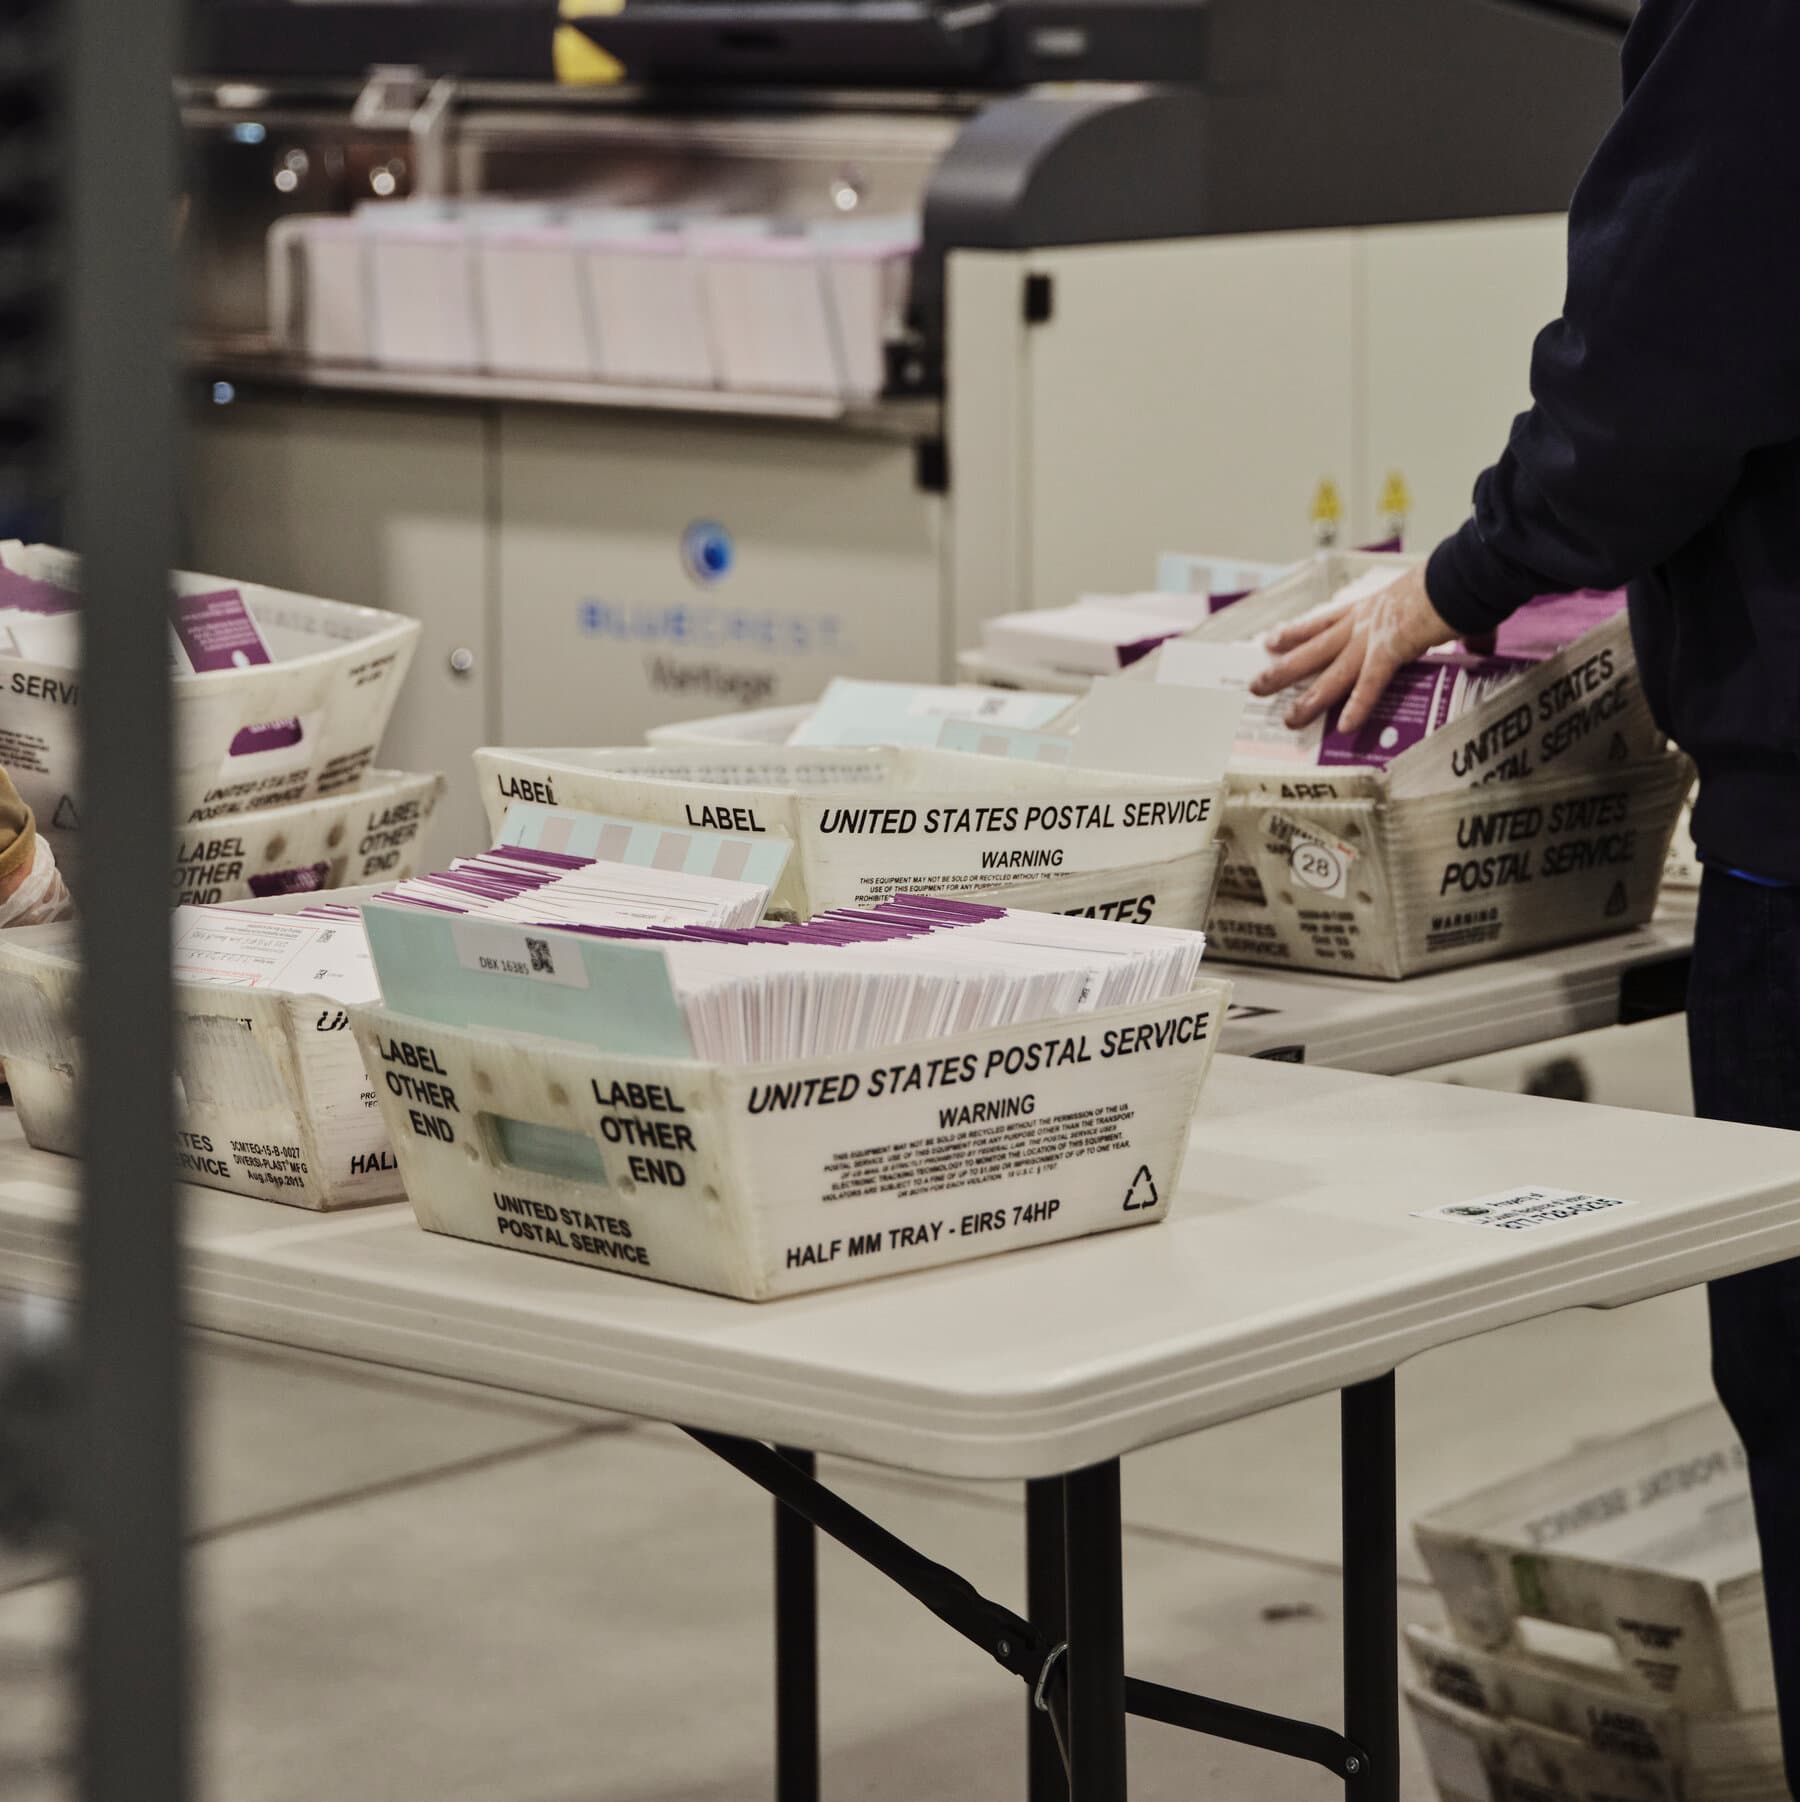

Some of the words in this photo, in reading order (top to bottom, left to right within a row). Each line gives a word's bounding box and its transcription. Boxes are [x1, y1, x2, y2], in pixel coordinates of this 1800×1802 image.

[1452, 702, 1533, 777] UNITED
[1539, 649, 1614, 720] STATES
[1541, 676, 1630, 762] SERVICE
[497, 774, 558, 806] LABEL
[366, 801, 420, 831] LABEL
[685, 804, 766, 832] LABEL
[819, 808, 917, 834] UNITED
[923, 806, 1019, 833] STATES
[1024, 804, 1115, 831] POSTAL
[1123, 798, 1211, 827] SERVICE
[1457, 806, 1542, 849] UNITED
[1547, 793, 1628, 833] STATES
[178, 838, 246, 863] LABEL
[360, 823, 419, 855] OTHER
[362, 850, 400, 877] END
[981, 848, 1064, 869] WARNING
[1302, 854, 1330, 878] 28
[1441, 852, 1533, 896] POSTAL
[1542, 829, 1637, 878] SERVICE
[1012, 872, 1039, 880] WITHOUT
[1431, 907, 1499, 930] WARNING
[479, 956, 498, 969] DBX
[376, 1034, 447, 1076] LABEL
[747, 1073, 860, 1114] UNITED
[867, 1054, 978, 1097] STATES
[984, 1035, 1092, 1079] POSTAL
[1100, 1011, 1210, 1058] SERVICE
[385, 1071, 460, 1112] OTHER
[592, 1078, 685, 1113] LABEL
[409, 1109, 455, 1143] END
[939, 1094, 1036, 1129] WARNING
[1096, 1112, 1135, 1124] TRANSPORT
[600, 1115, 697, 1152] OTHER
[289, 1161, 308, 1173] MFG
[628, 1155, 686, 1187] END
[493, 1192, 558, 1222] UNITED
[560, 1208, 632, 1238] STATES
[497, 1217, 569, 1247] POSTAL
[570, 1233, 651, 1266] SERVICE
[786, 1240, 842, 1269] HALF
[848, 1232, 882, 1257] MM
[889, 1220, 943, 1249] TRAY
[961, 1209, 1006, 1236] EIRS
[1013, 1199, 1061, 1226] 74HP
